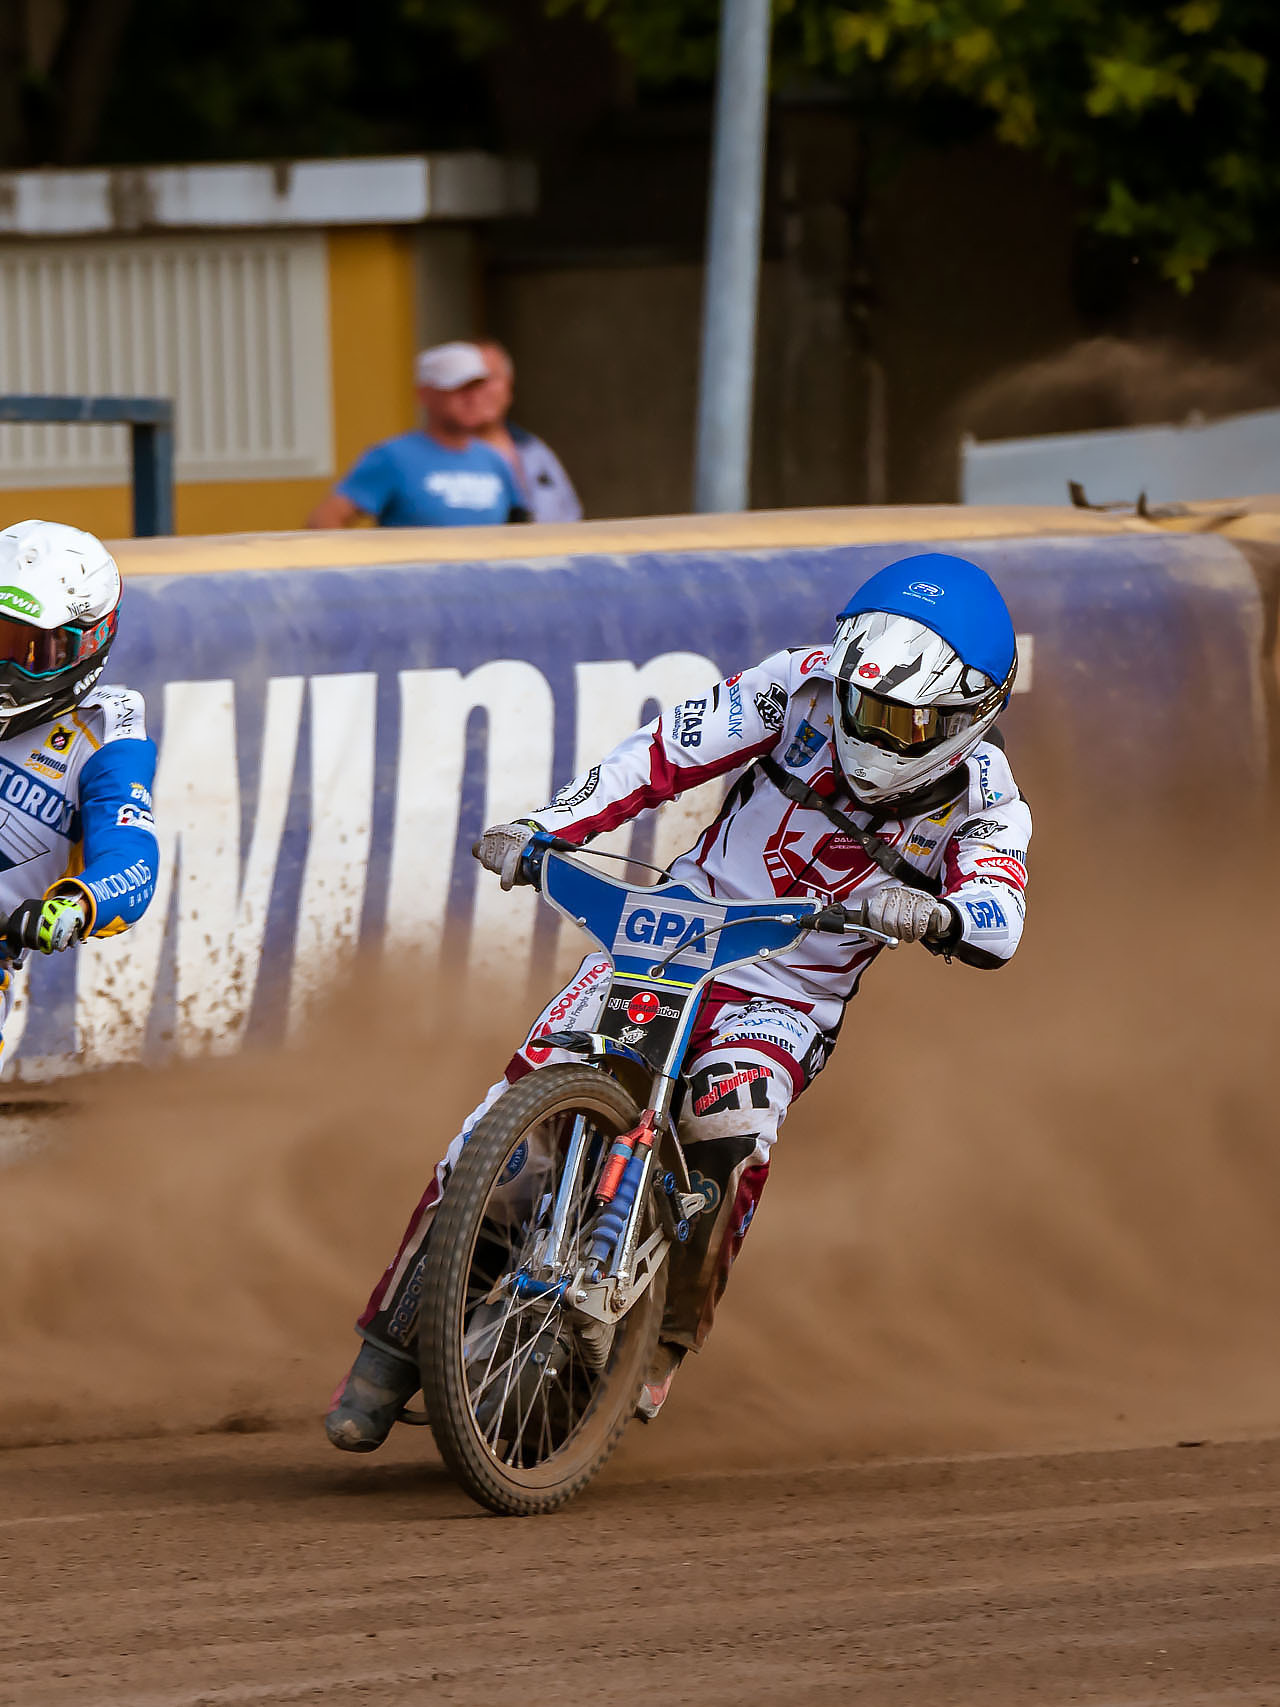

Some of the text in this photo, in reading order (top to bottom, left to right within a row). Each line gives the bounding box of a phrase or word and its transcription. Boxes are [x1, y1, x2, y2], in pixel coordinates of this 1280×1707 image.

[965, 899, 1008, 929] GPA
[625, 908, 707, 954] GPA
[719, 1067, 760, 1097] Montage
